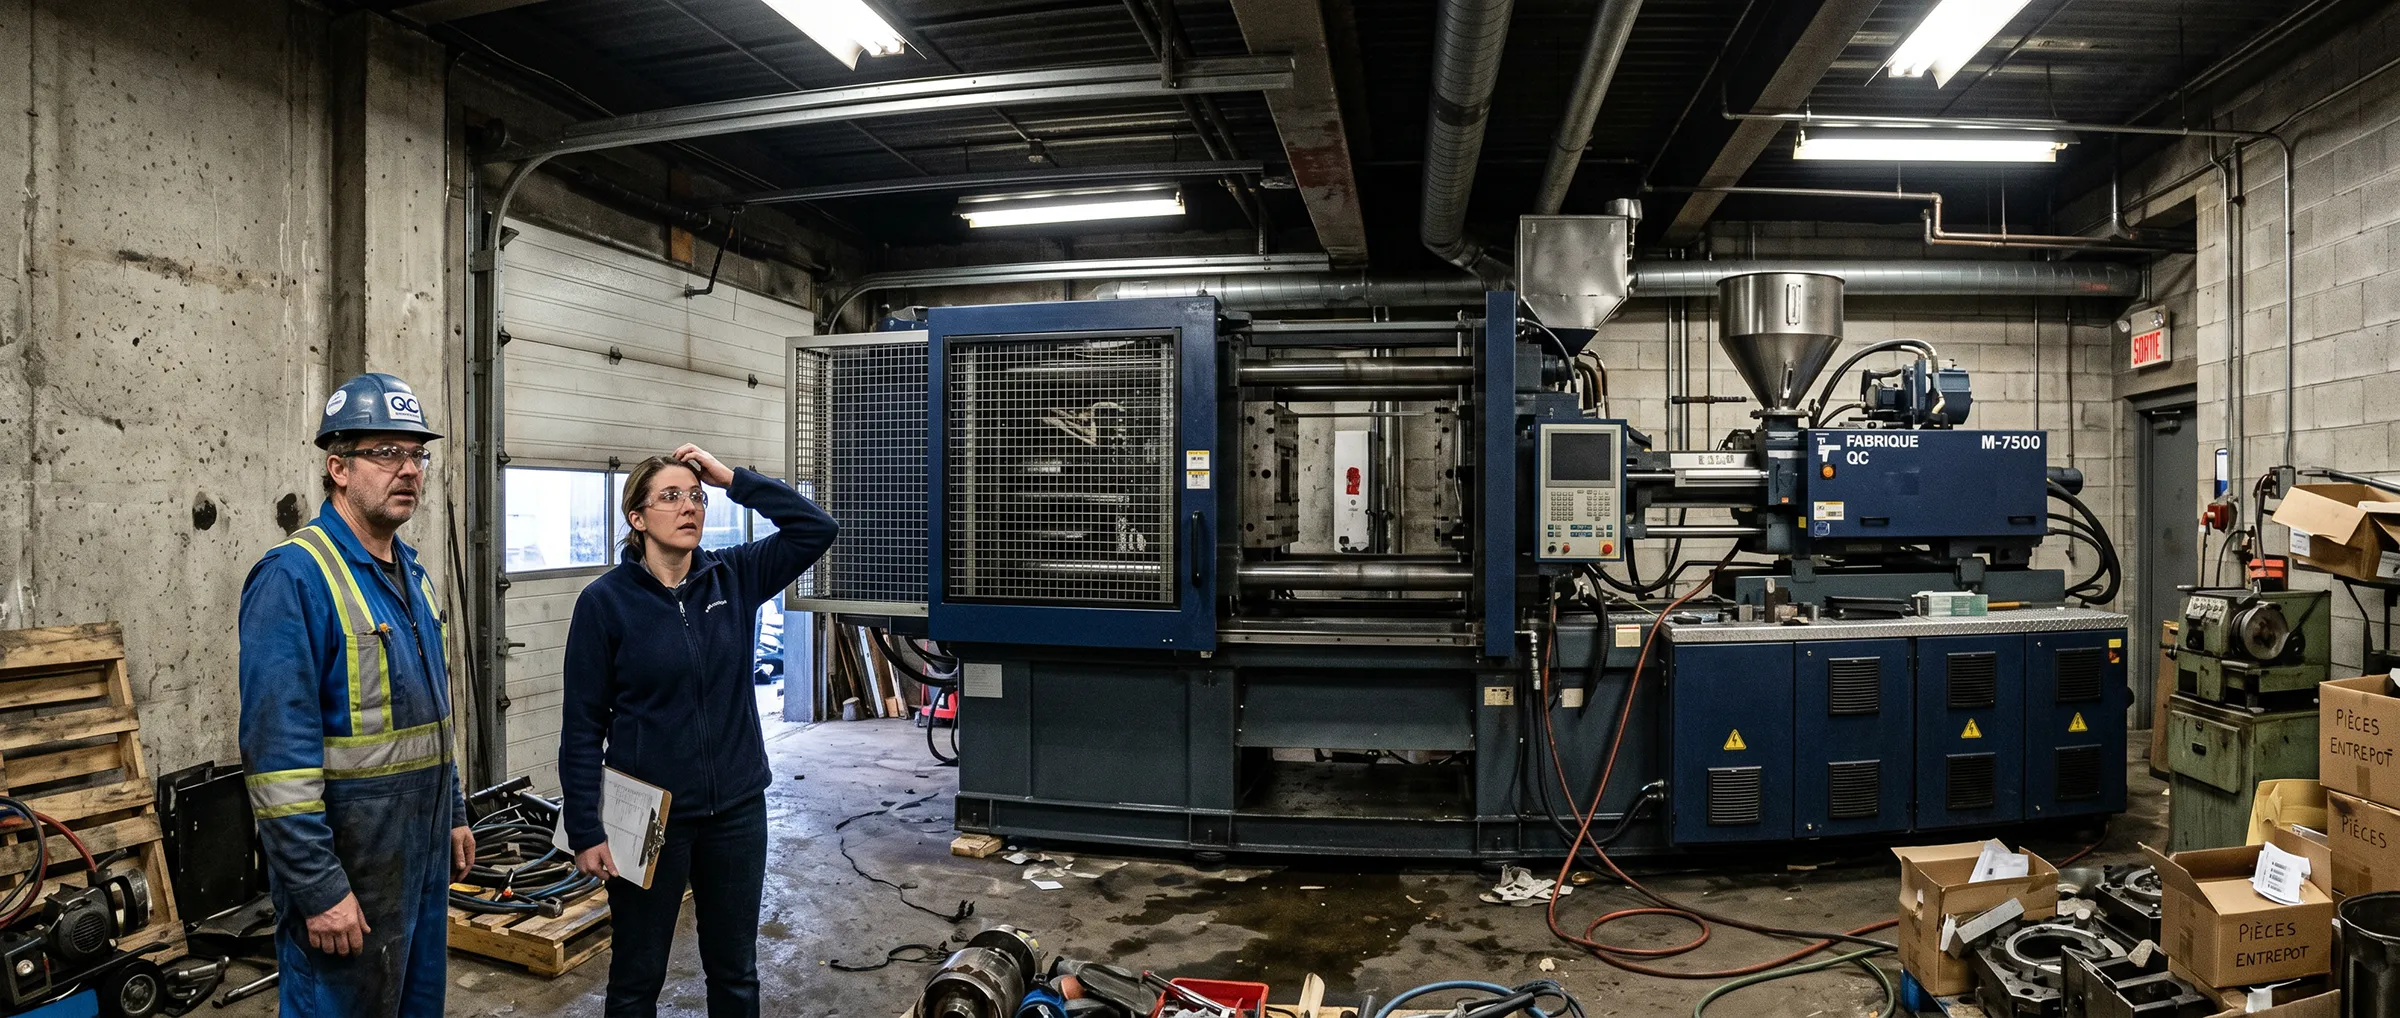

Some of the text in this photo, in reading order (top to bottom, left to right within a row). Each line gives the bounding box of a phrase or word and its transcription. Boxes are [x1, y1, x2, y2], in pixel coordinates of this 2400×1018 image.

[2133, 331, 2162, 365] SORTIE
[390, 396, 419, 414] QC
[1846, 434, 1919, 448] FABRIQUE
[1981, 434, 2041, 450] M-7500
[1846, 450, 1870, 465] QC
[2336, 708, 2380, 736] PIÈCES
[2235, 945, 2310, 968] ENTREPOT
